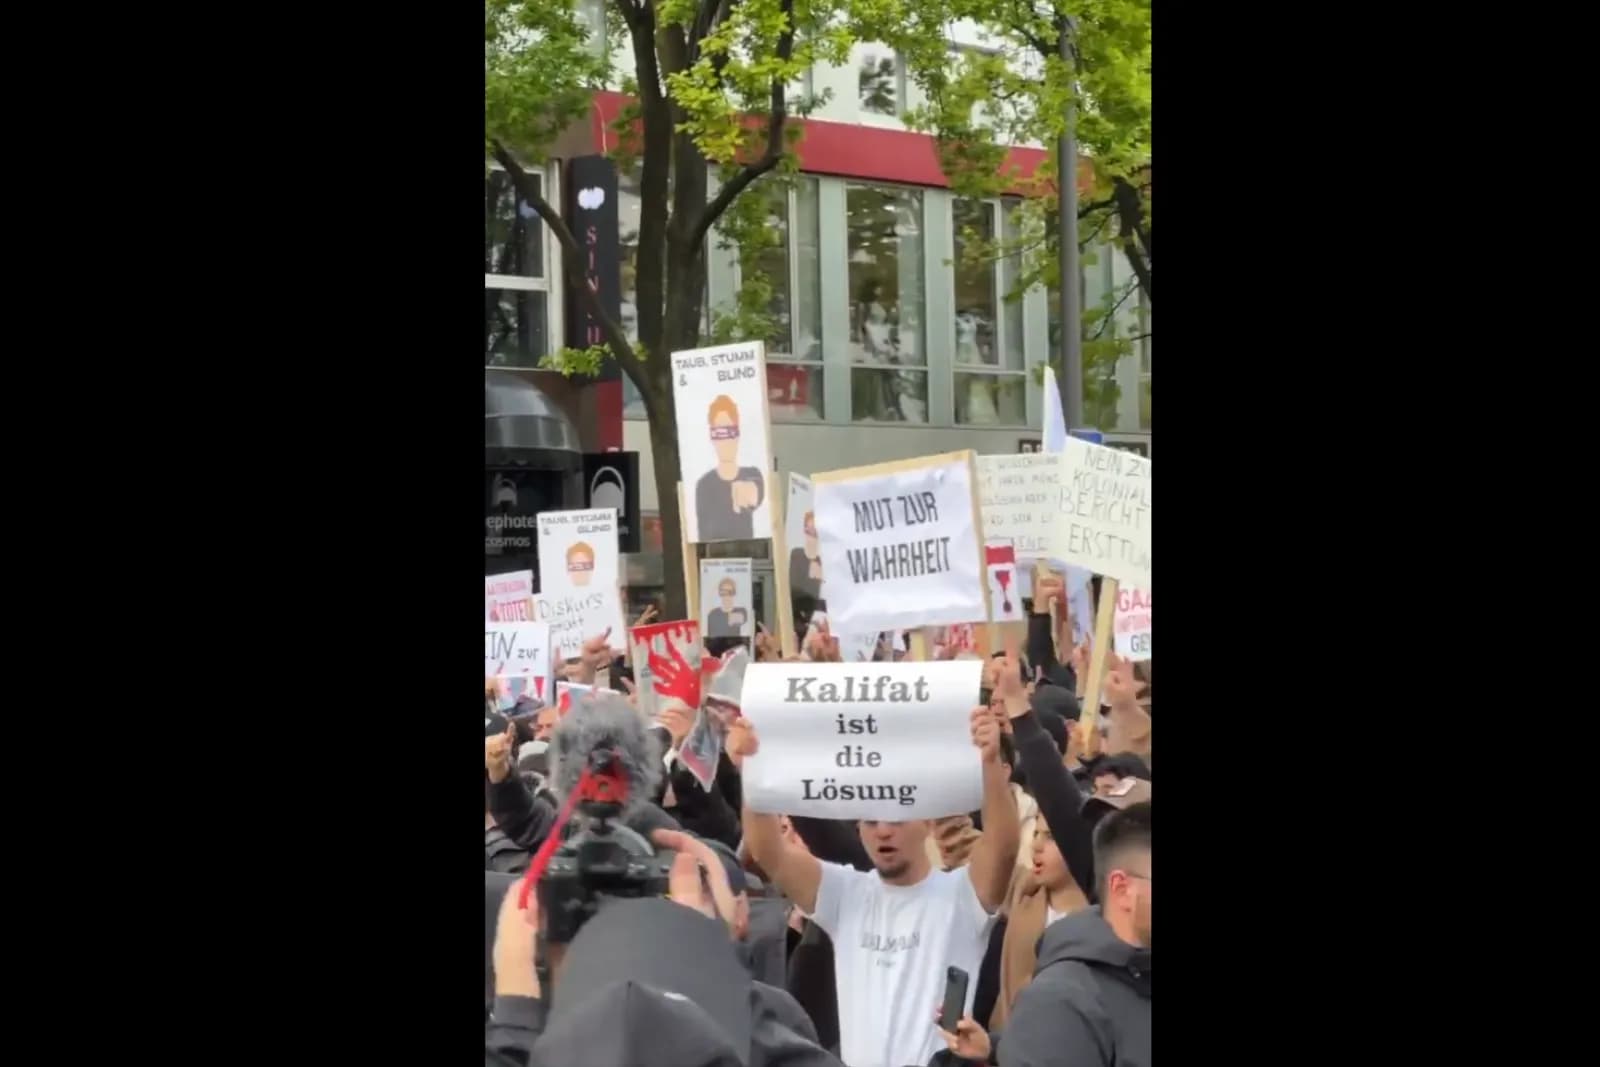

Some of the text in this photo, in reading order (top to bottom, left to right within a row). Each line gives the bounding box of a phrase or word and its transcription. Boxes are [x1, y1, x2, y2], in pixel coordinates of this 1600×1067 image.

[679, 366, 756, 387] & BLIND
[1084, 448, 1121, 475] NEIN
[852, 491, 939, 533] MUT ZUR
[1058, 485, 1147, 530] BERICHT
[847, 537, 950, 584] WAHRHEIT
[517, 647, 540, 660] zur
[784, 674, 931, 703] Kalifat
[835, 713, 878, 735] ist
[835, 744, 882, 768] die
[801, 777, 918, 806] Lösung
